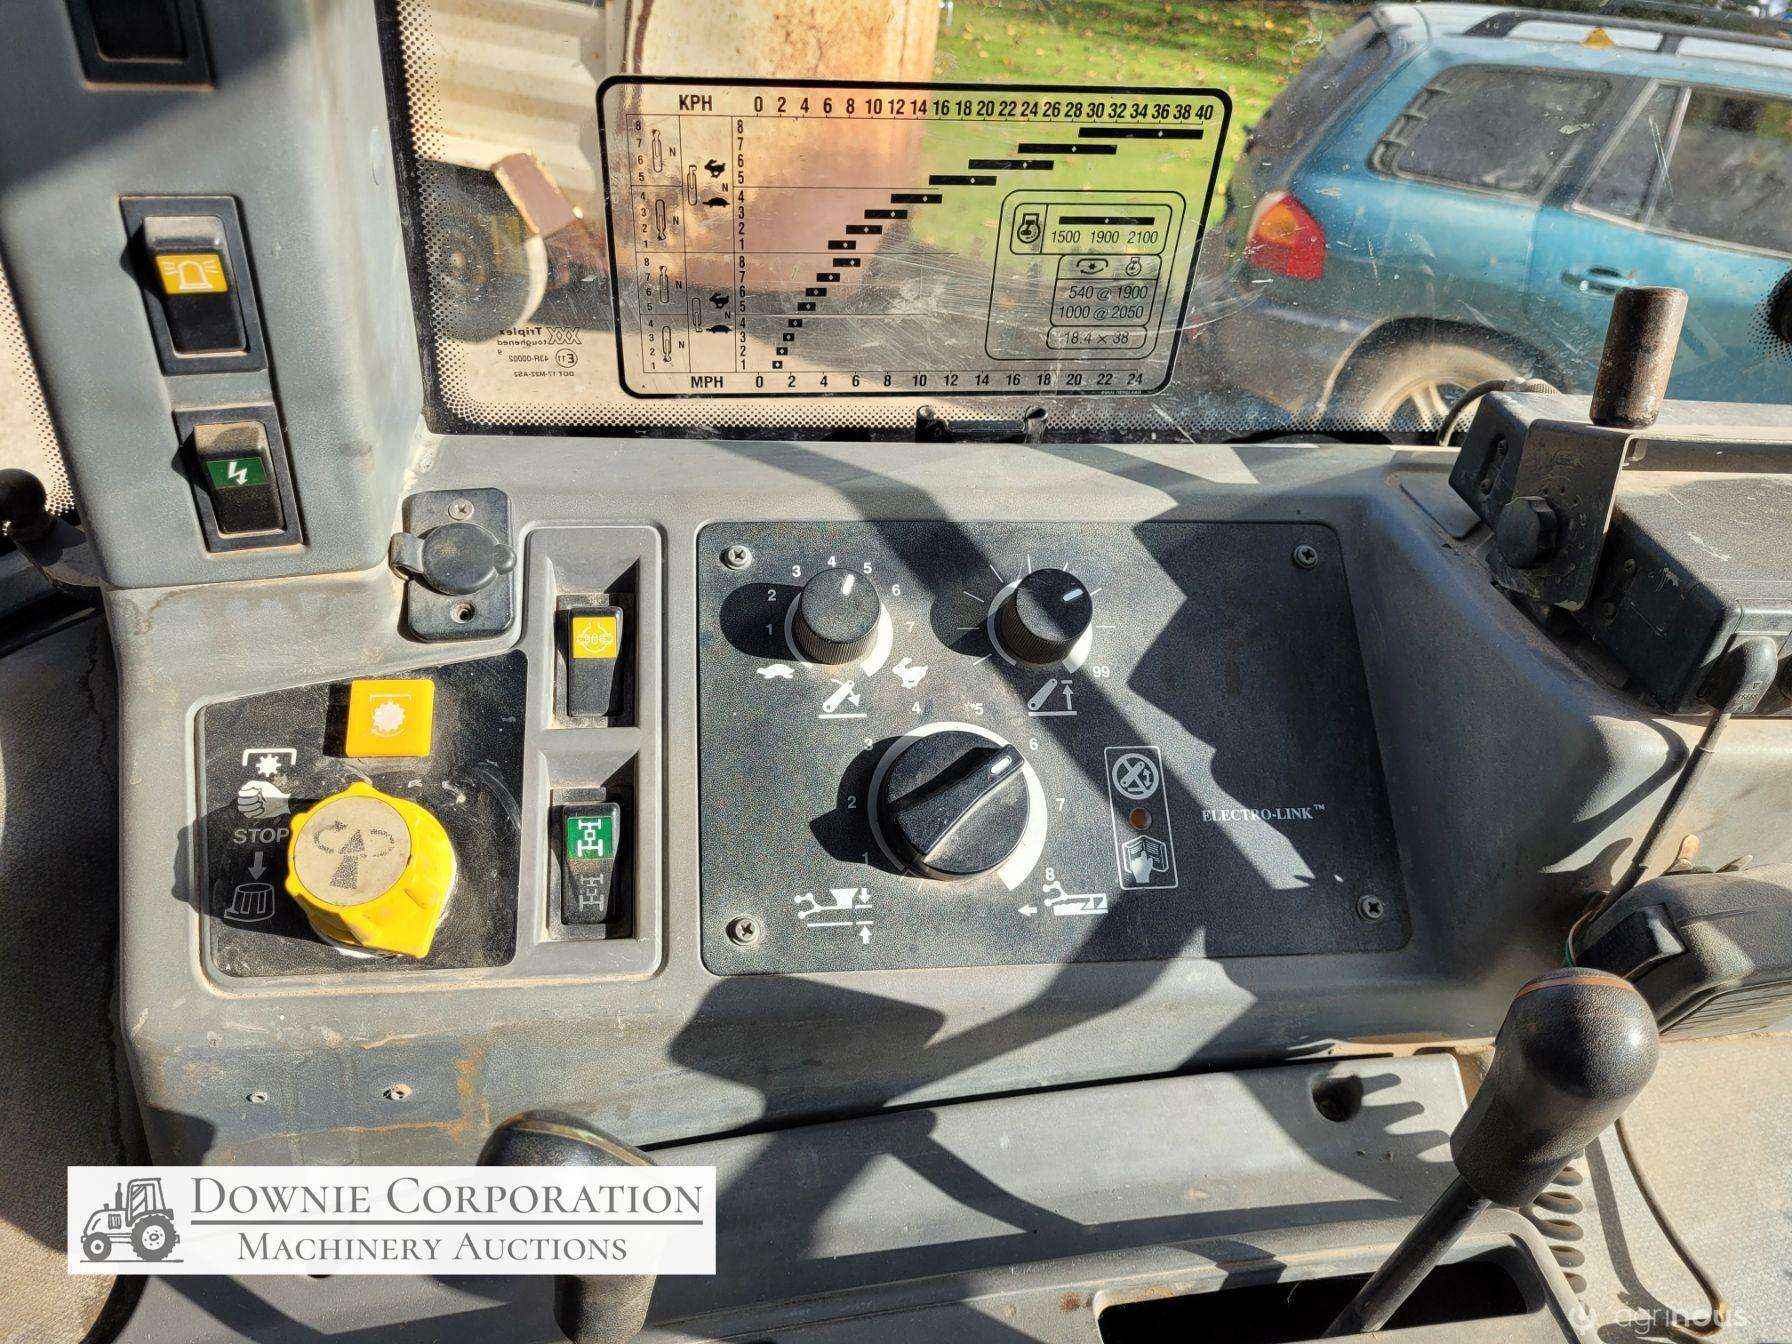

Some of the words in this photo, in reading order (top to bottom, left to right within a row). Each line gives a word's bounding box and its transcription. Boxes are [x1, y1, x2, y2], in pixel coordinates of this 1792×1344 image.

[679, 94, 713, 111] KPH
[754, 97, 763, 111] 0
[777, 97, 787, 112] 2
[799, 97, 809, 113] 4
[823, 98, 832, 113] 6
[846, 98, 855, 114] 8
[865, 98, 882, 114] 10
[888, 99, 905, 114] 12
[910, 99, 927, 115] 14
[933, 100, 950, 115] 16
[956, 100, 972, 116] 18
[976, 100, 995, 116] 20
[999, 101, 1017, 116] 22
[1021, 101, 1039, 117] 24
[1043, 101, 1060, 117] 26
[1064, 102, 1083, 118] 28
[1086, 102, 1105, 118] 30
[1108, 103, 1126, 119] 32
[1129, 103, 1148, 119] 34
[1151, 103, 1170, 119] 36
[1173, 104, 1191, 120] 38
[1195, 104, 1213, 120] 40
[636, 121, 641, 130] 8
[738, 120, 743, 133] 8
[636, 139, 641, 148] 7
[738, 137, 743, 150] 7
[670, 148, 676, 156] N
[638, 155, 643, 164] 6
[738, 154, 744, 167] 6
[639, 172, 644, 181] 5
[738, 172, 744, 184] 5
[722, 183, 728, 192] N
[640, 192, 645, 200] 4
[738, 190, 744, 203] 4
[641, 208, 646, 217] 3
[738, 207, 744, 219] 3
[673, 216, 679, 225] N
[643, 224, 647, 232] 2
[739, 222, 744, 235] 2
[1051, 230, 1081, 244] 1500
[1090, 230, 1119, 244] 1900
[1128, 230, 1158, 244] 2100
[644, 240, 648, 248] 1
[740, 238, 744, 250] 1
[644, 258, 649, 266] 8
[739, 256, 745, 268] 8
[645, 273, 650, 281] 7
[739, 271, 745, 283] 7
[647, 288, 651, 296] 6
[740, 286, 745, 297] 6
[1069, 285, 1093, 299] 540
[1097, 288, 1112, 301] @
[1117, 285, 1148, 299] 1900
[648, 303, 652, 311] 5
[740, 301, 745, 312] 5
[1059, 306, 1090, 319] 1000
[1094, 308, 1109, 320] @
[1111, 305, 1144, 319] 2050
[740, 318, 745, 328] 4
[740, 332, 745, 343] 3
[1064, 331, 1092, 345] 18.4
[1112, 331, 1129, 345] 38
[650, 348, 655, 356] 2
[740, 346, 746, 356] 2
[741, 360, 745, 370] 1
[691, 376, 723, 388] MPH
[755, 375, 764, 388] 0
[788, 375, 796, 388] 2
[820, 375, 828, 387] 4
[851, 375, 860, 387] 6
[883, 374, 892, 387] 8
[912, 375, 927, 387] 10
[944, 374, 958, 386] 12
[975, 374, 990, 386] 14
[1006, 374, 1021, 386] 16
[1037, 373, 1051, 386] 18
[1067, 373, 1082, 386] 20
[1097, 373, 1114, 386] 22
[1127, 373, 1143, 385] 24
[828, 556, 836, 567] 4
[792, 565, 801, 577] 3
[863, 562, 872, 574] 5
[768, 589, 776, 601] 2
[892, 584, 901, 596] 6
[766, 624, 772, 635] 1
[906, 622, 915, 633] 7
[1093, 666, 1110, 678] 99
[912, 702, 921, 714] 4
[974, 702, 984, 715] 5
[863, 738, 873, 750] 3
[1029, 738, 1038, 750] 6
[848, 796, 857, 808] 2
[1056, 799, 1065, 810] 7
[233, 828, 290, 844] STOP
[863, 852, 868, 864] 1
[1045, 868, 1055, 880] 8
